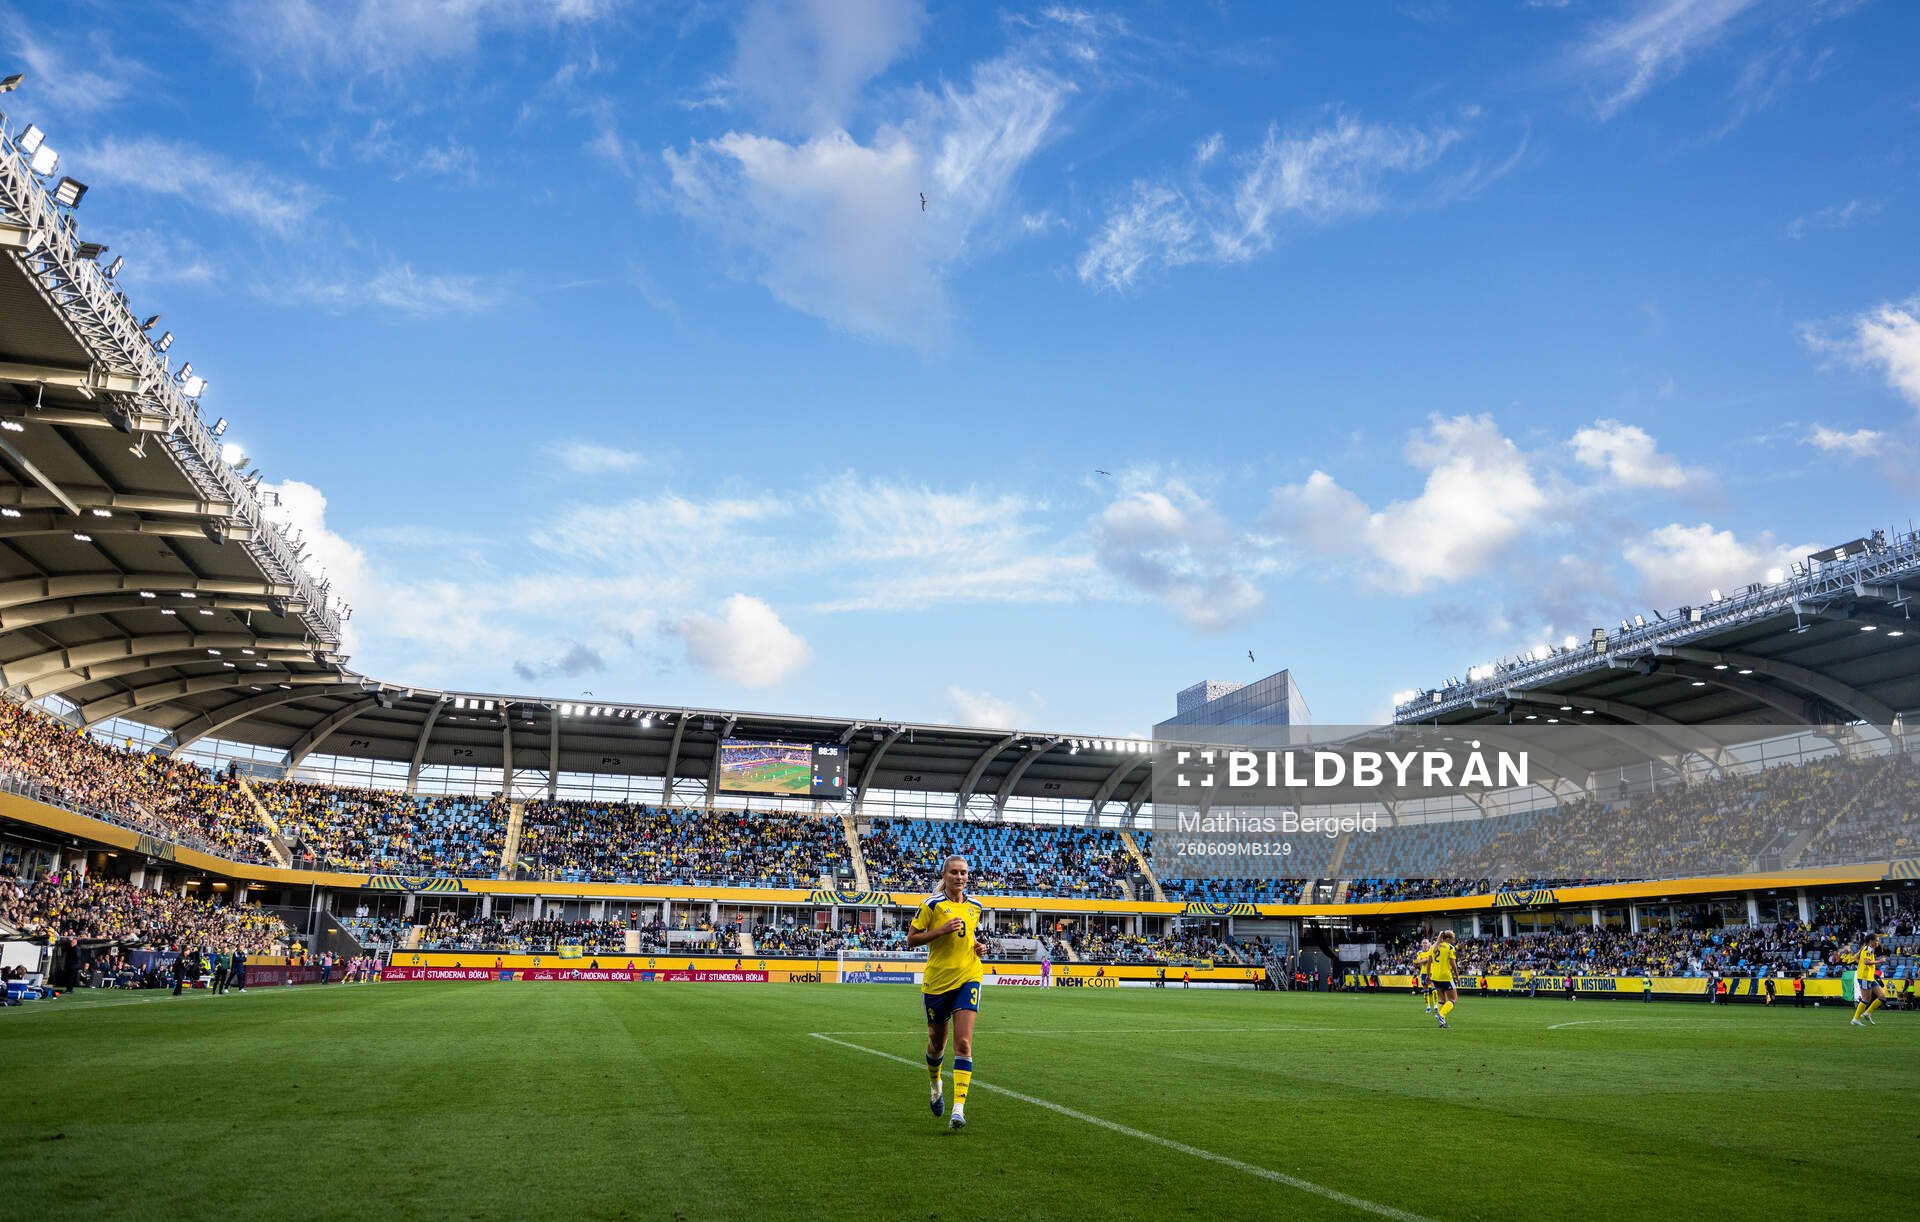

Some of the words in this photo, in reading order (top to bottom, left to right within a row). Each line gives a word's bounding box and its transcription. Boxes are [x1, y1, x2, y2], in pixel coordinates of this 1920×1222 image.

[350, 740, 370, 748] P1
[454, 748, 473, 757] P2
[602, 757, 621, 765] P3
[1434, 951, 1441, 963] 2
[427, 970, 466, 979] STUNDERNA
[468, 970, 489, 979] BÖRJA
[611, 971, 631, 980] BÖRJA
[708, 972, 743, 981] STUNDERNA
[745, 972, 764, 981] BÖRJA
[789, 973, 821, 983] kvdbil
[997, 976, 1041, 986] Interbus
[1581, 978, 1617, 990] HISTORIA
[970, 987, 978, 1006] 3
